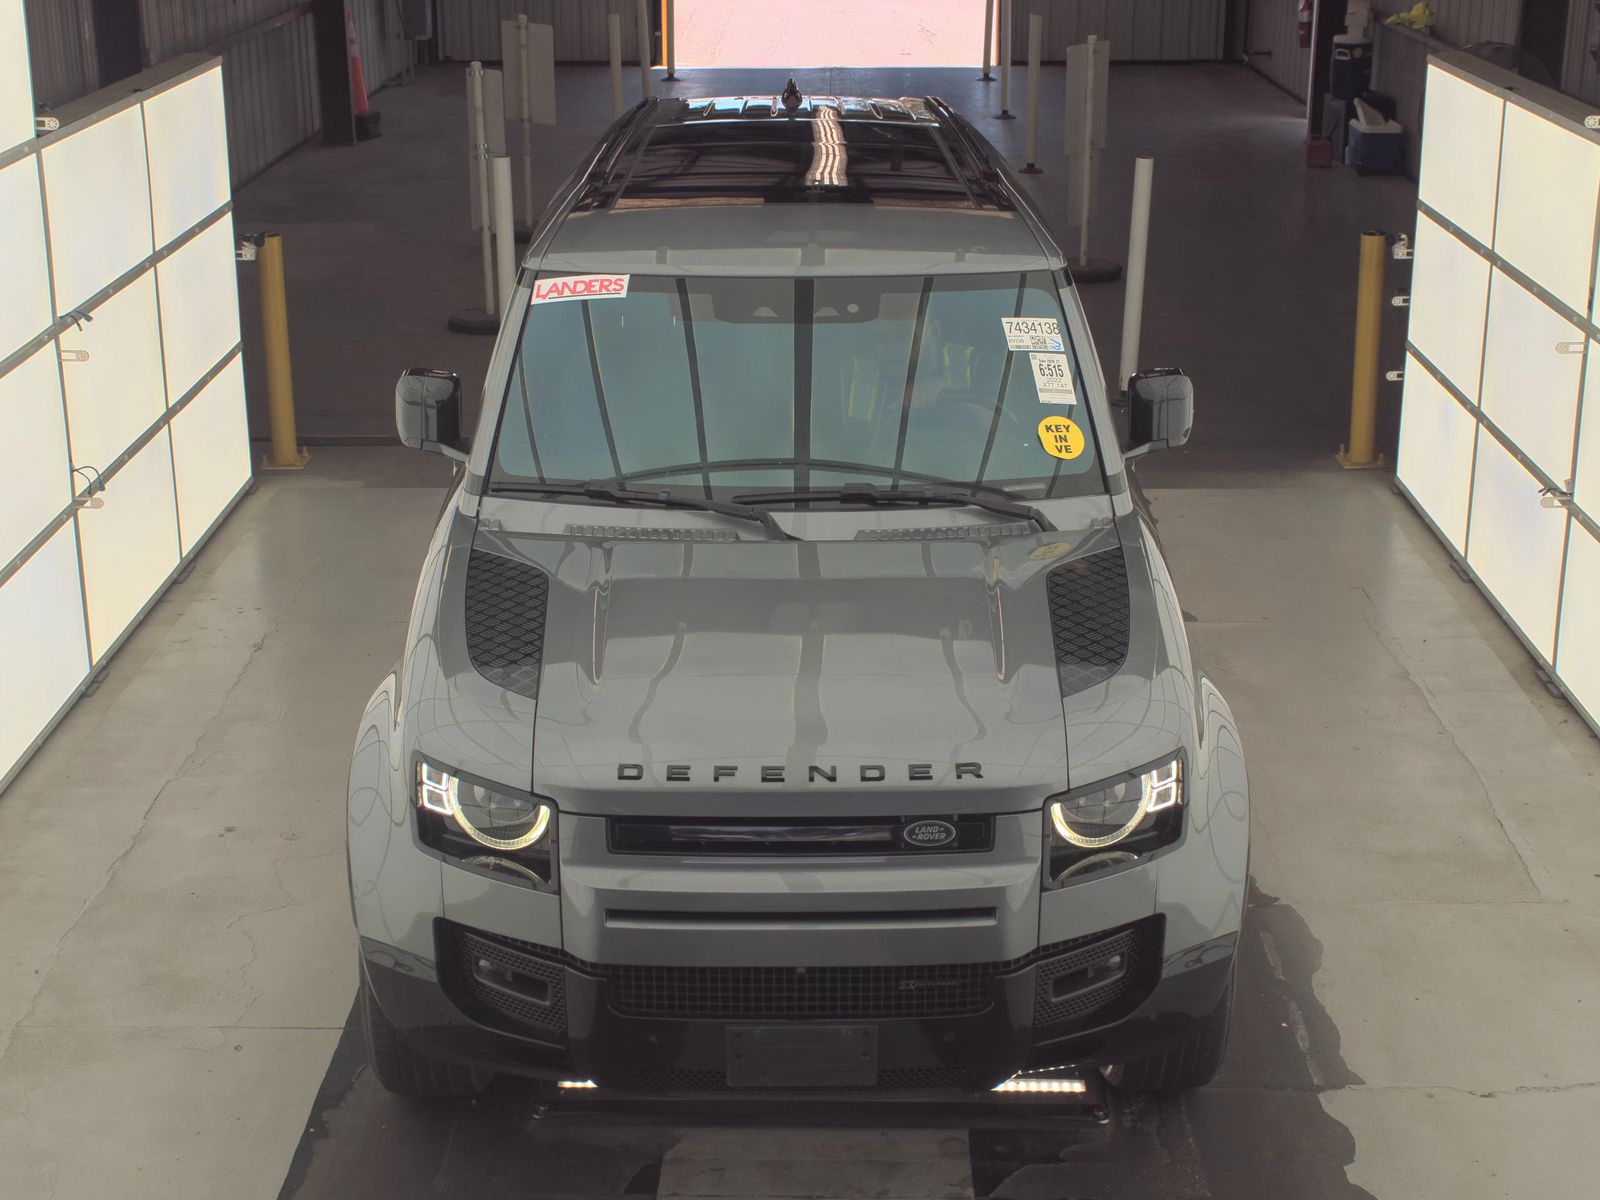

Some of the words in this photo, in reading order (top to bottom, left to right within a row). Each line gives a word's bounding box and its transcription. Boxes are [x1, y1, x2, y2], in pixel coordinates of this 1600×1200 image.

[535, 278, 625, 299] LANDERS
[1005, 321, 1061, 335] 7434138
[1039, 363, 1064, 378] 6:515
[1045, 424, 1071, 433] KEY
[1054, 434, 1069, 444] IN
[1054, 444, 1073, 454] VE
[617, 762, 984, 783] DEFENDER
